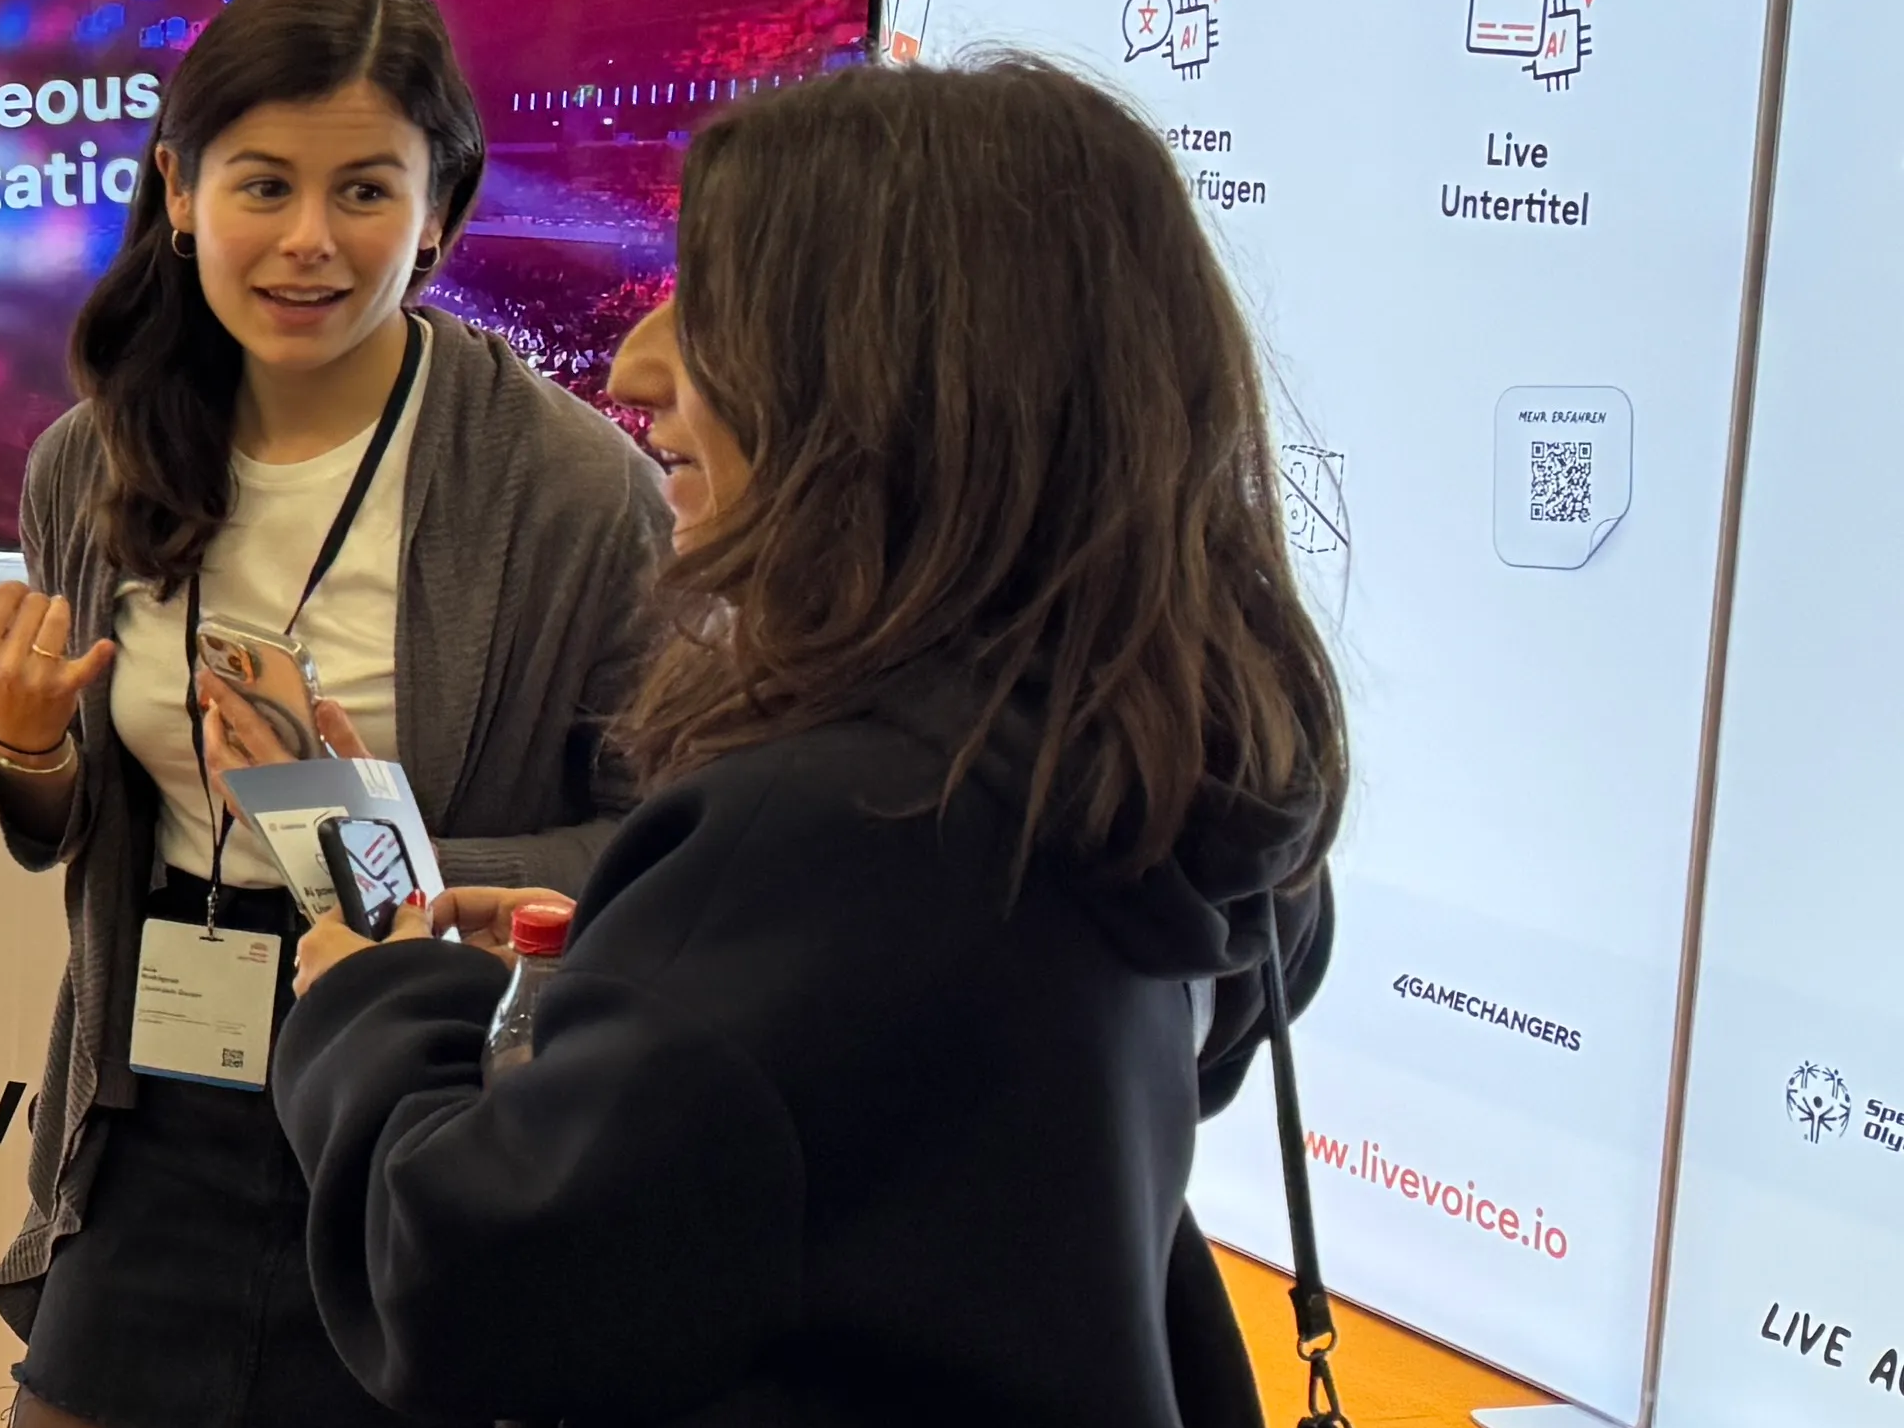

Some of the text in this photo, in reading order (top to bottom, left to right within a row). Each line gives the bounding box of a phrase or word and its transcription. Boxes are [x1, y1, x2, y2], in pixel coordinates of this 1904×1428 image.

[1165, 124, 1232, 153] etzen
[1486, 132, 1550, 168] Live
[1195, 169, 1267, 210] fügen
[1440, 184, 1590, 227] Untertitel
[1518, 409, 1607, 425] MEHR ERFAHREN
[1392, 973, 1583, 1052] 4GAMECHANGERS
[1865, 1097, 1904, 1128] Spe
[1863, 1121, 1904, 1153] Oly
[1760, 1301, 1852, 1369] LIVE
